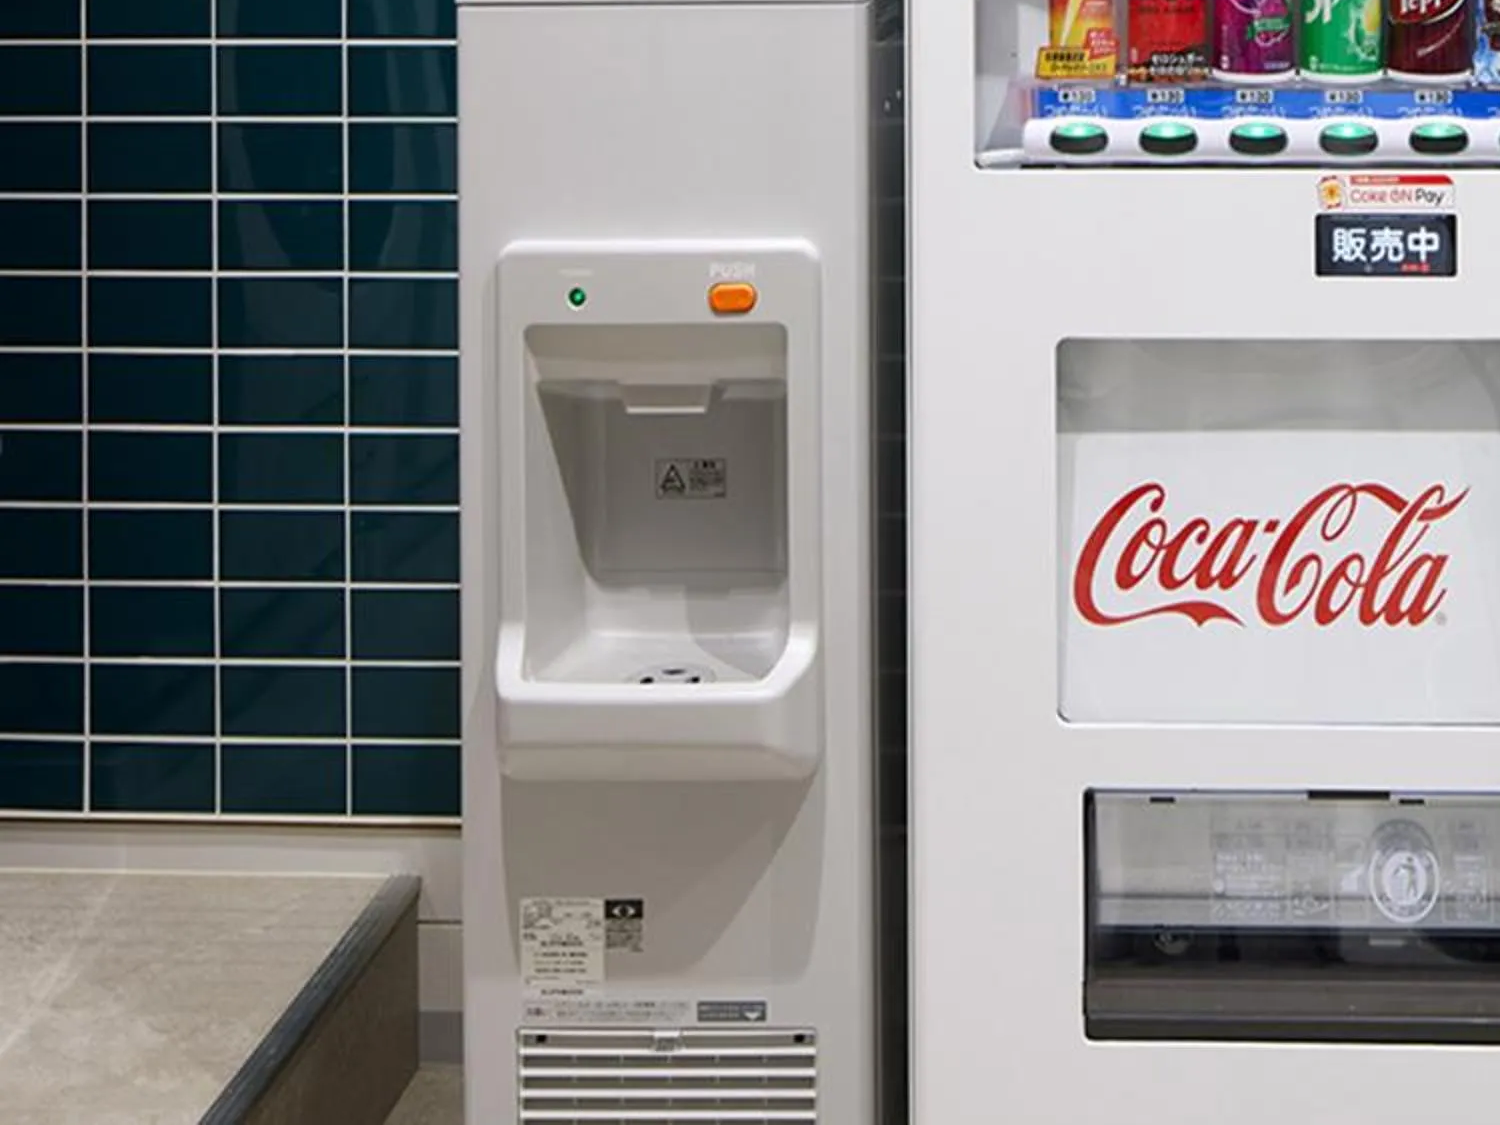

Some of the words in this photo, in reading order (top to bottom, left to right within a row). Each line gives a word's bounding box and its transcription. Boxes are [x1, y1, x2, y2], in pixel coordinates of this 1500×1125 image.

[1351, 189, 1388, 203] Coke
[1415, 188, 1445, 206] Pay
[1332, 226, 1440, 262] 販売中
[710, 263, 756, 278] PUSH
[1074, 482, 1470, 628] Coca-Cola
